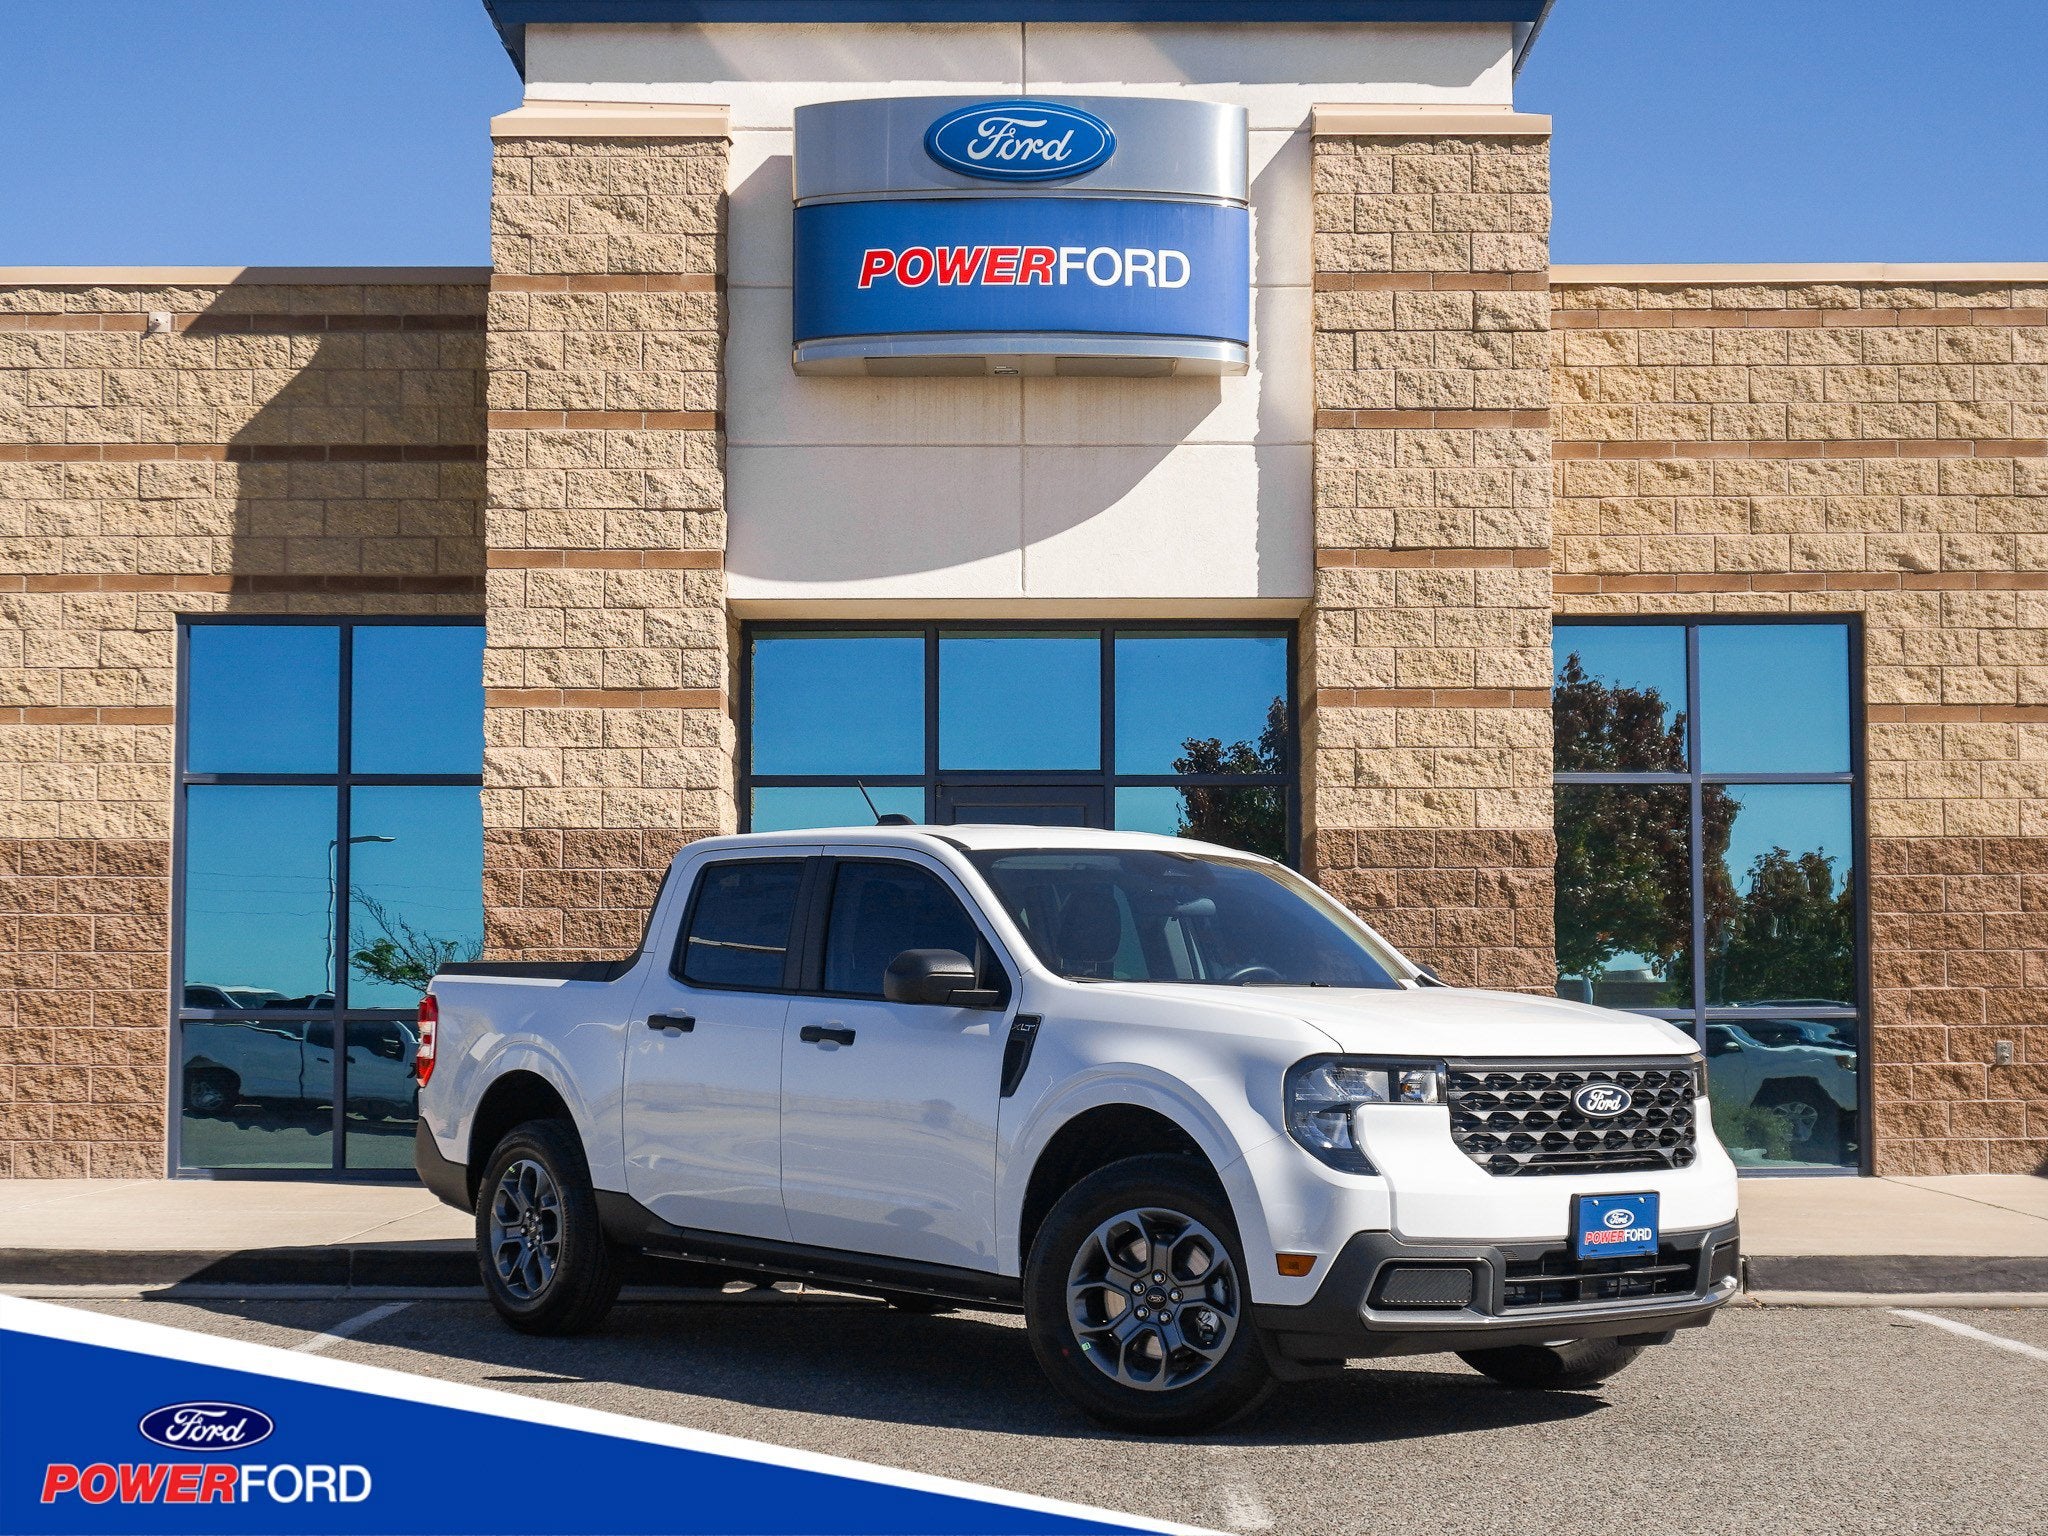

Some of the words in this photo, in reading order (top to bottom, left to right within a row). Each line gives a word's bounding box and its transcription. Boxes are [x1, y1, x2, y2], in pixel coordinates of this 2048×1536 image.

[967, 117, 1074, 160] Ford
[1012, 1023, 1036, 1032] XLT
[1586, 1089, 1622, 1111] Ford
[1610, 1212, 1628, 1224] Ford
